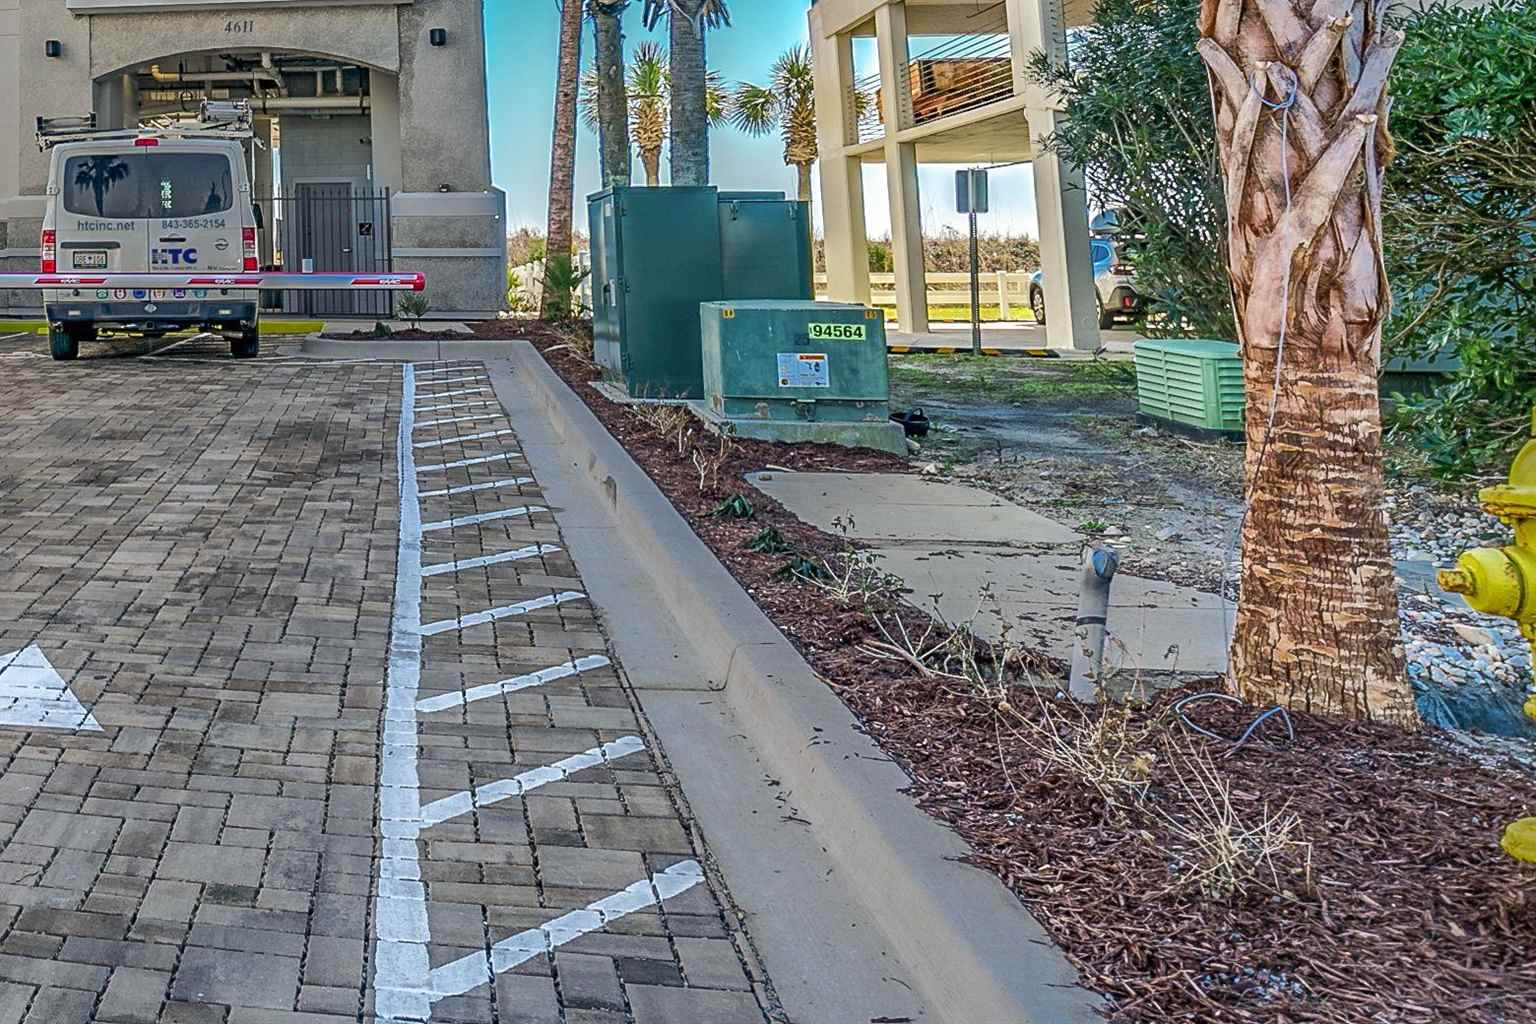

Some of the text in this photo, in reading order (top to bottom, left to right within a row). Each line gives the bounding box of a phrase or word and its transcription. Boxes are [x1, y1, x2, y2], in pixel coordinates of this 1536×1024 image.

[224, 20, 254, 33] 4611
[77, 220, 136, 231] htcinc.net
[151, 248, 198, 264] HTC
[813, 324, 863, 338] 94564
